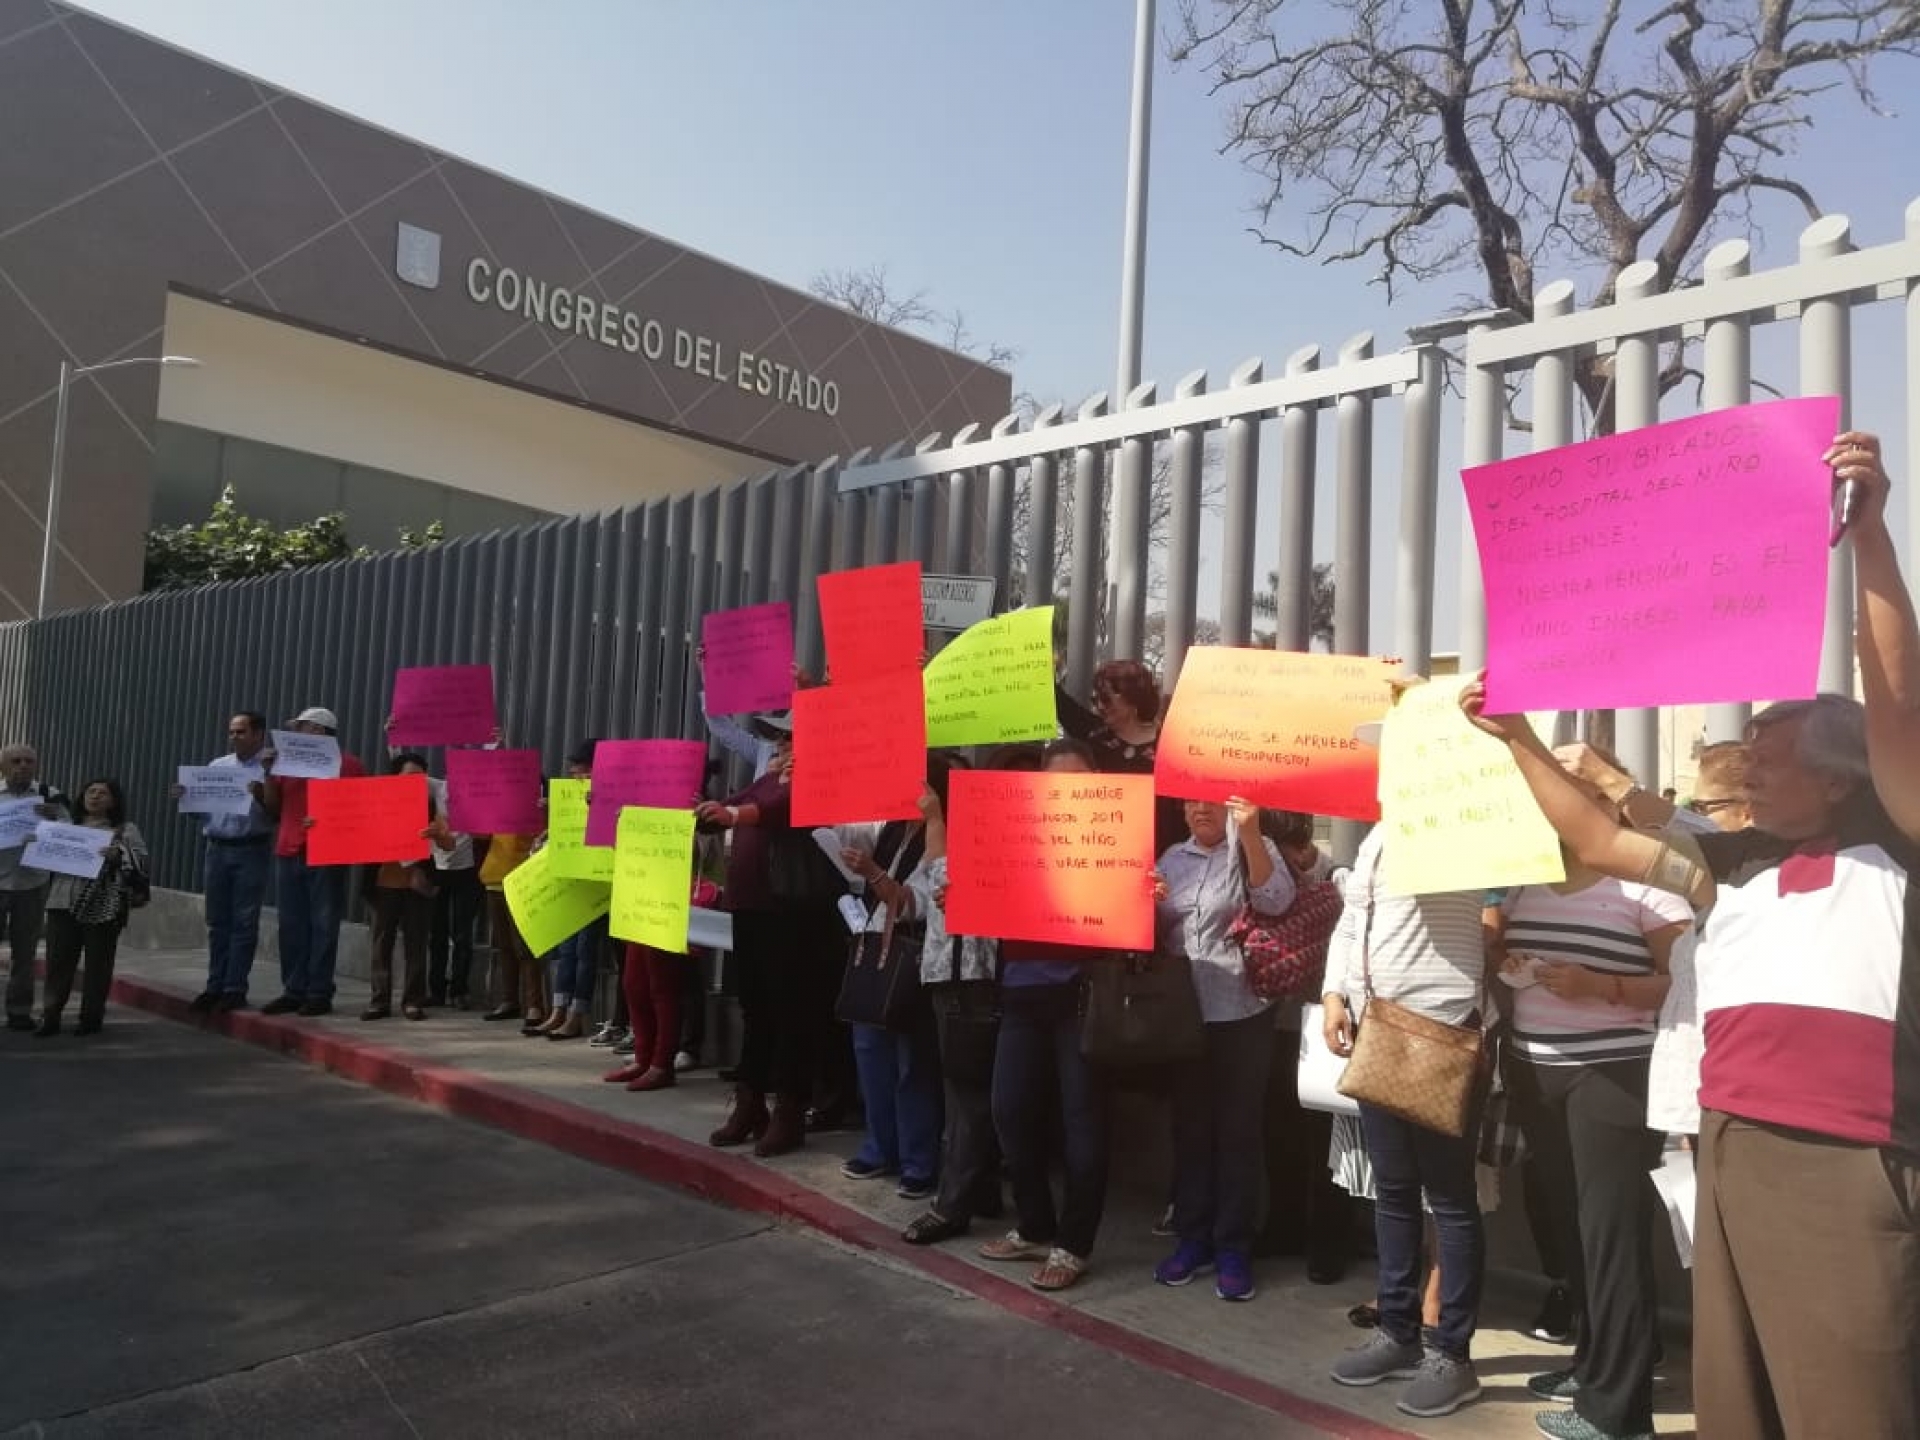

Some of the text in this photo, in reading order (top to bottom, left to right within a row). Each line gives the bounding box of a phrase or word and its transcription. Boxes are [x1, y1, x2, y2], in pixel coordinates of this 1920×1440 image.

[467, 257, 839, 416] CONGRESO DEL ESTADO
[1294, 734, 1359, 750] APRUEBE
[1188, 745, 1205, 756] EL
[1090, 811, 1124, 825] 2019
